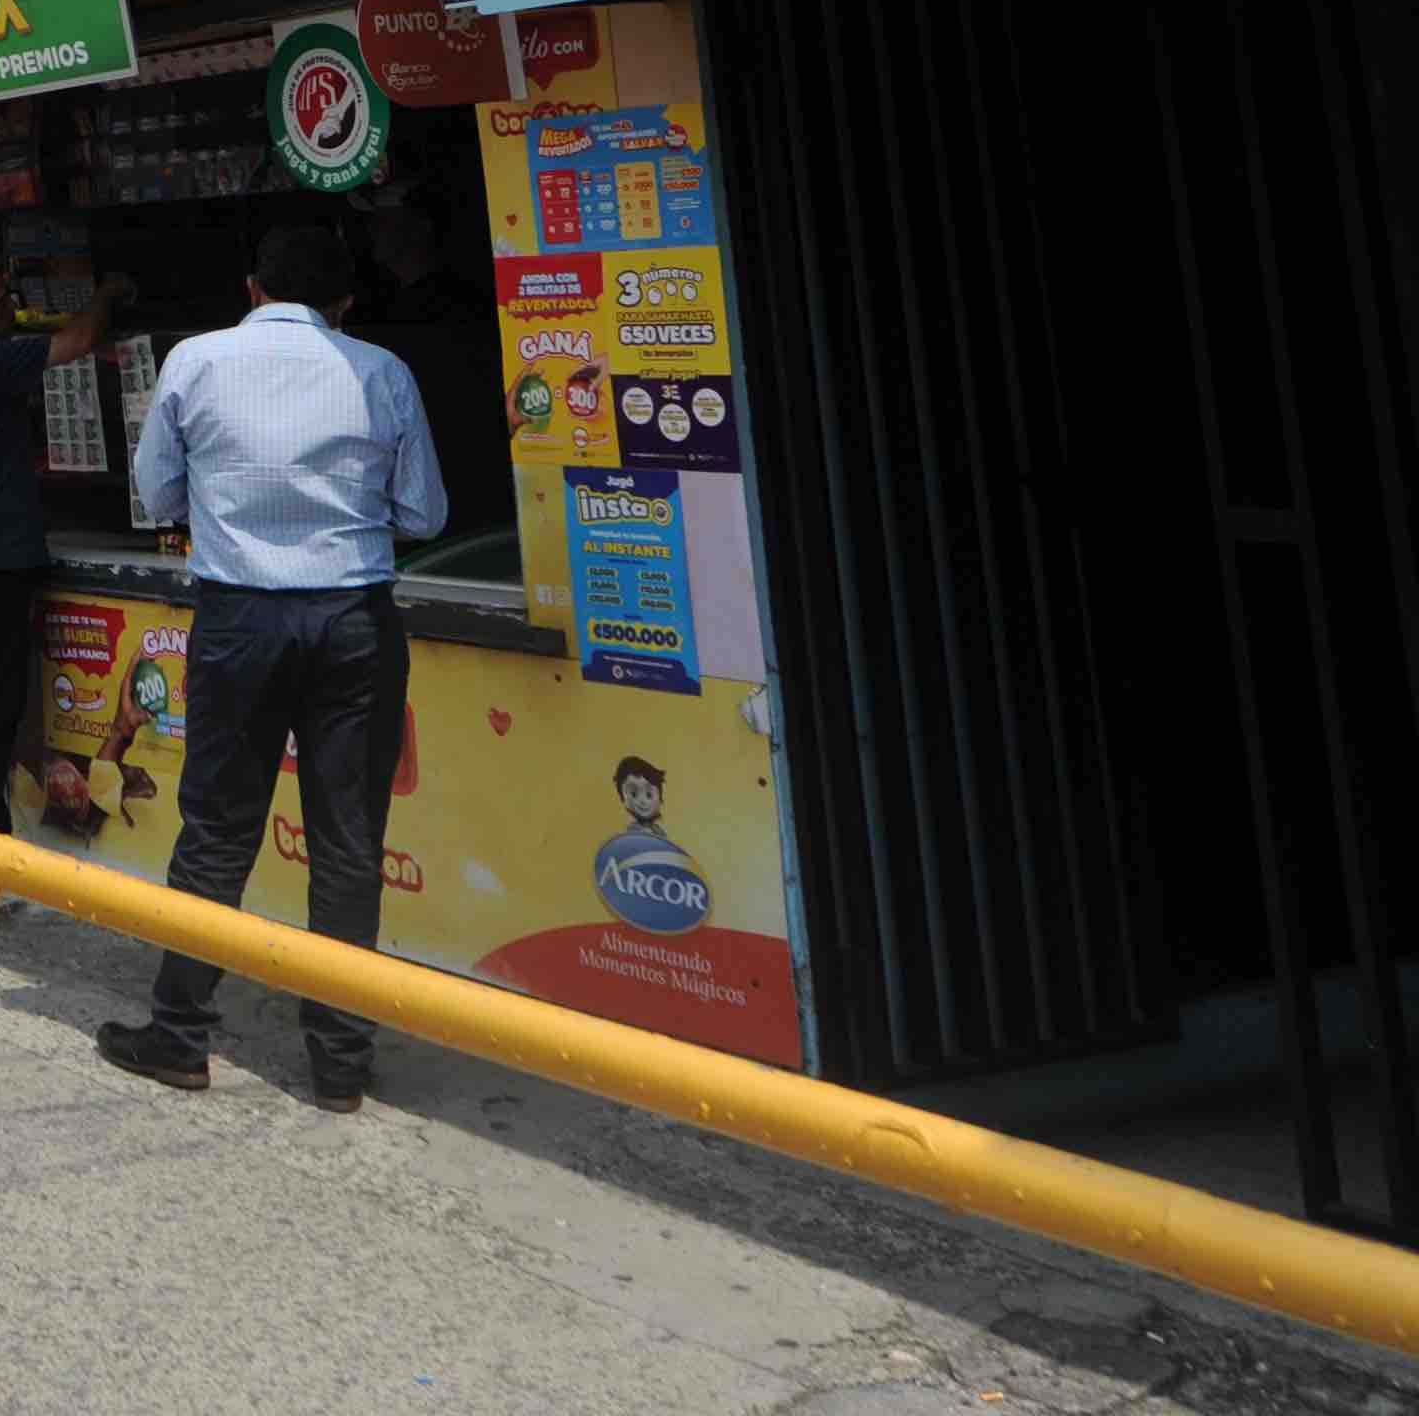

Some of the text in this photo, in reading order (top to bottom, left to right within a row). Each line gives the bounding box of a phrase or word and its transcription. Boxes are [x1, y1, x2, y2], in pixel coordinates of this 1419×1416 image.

[374, 12, 439, 34] PUNTO
[0, 40, 90, 81] PREMIOS
[540, 127, 575, 145] MEGA
[555, 272, 579, 283] CON
[617, 271, 642, 306] 3
[519, 330, 592, 361] GANÁ
[619, 323, 714, 345] 650 VECES
[521, 386, 550, 410] 200
[566, 385, 597, 410] 300
[577, 489, 649, 521] insta
[603, 542, 672, 559] INSTANTE
[136, 672, 167, 705] 200
[600, 856, 708, 911] ARCOR
[600, 931, 715, 974] Alimentando
[579, 945, 748, 1006] Momentos Mágicos
